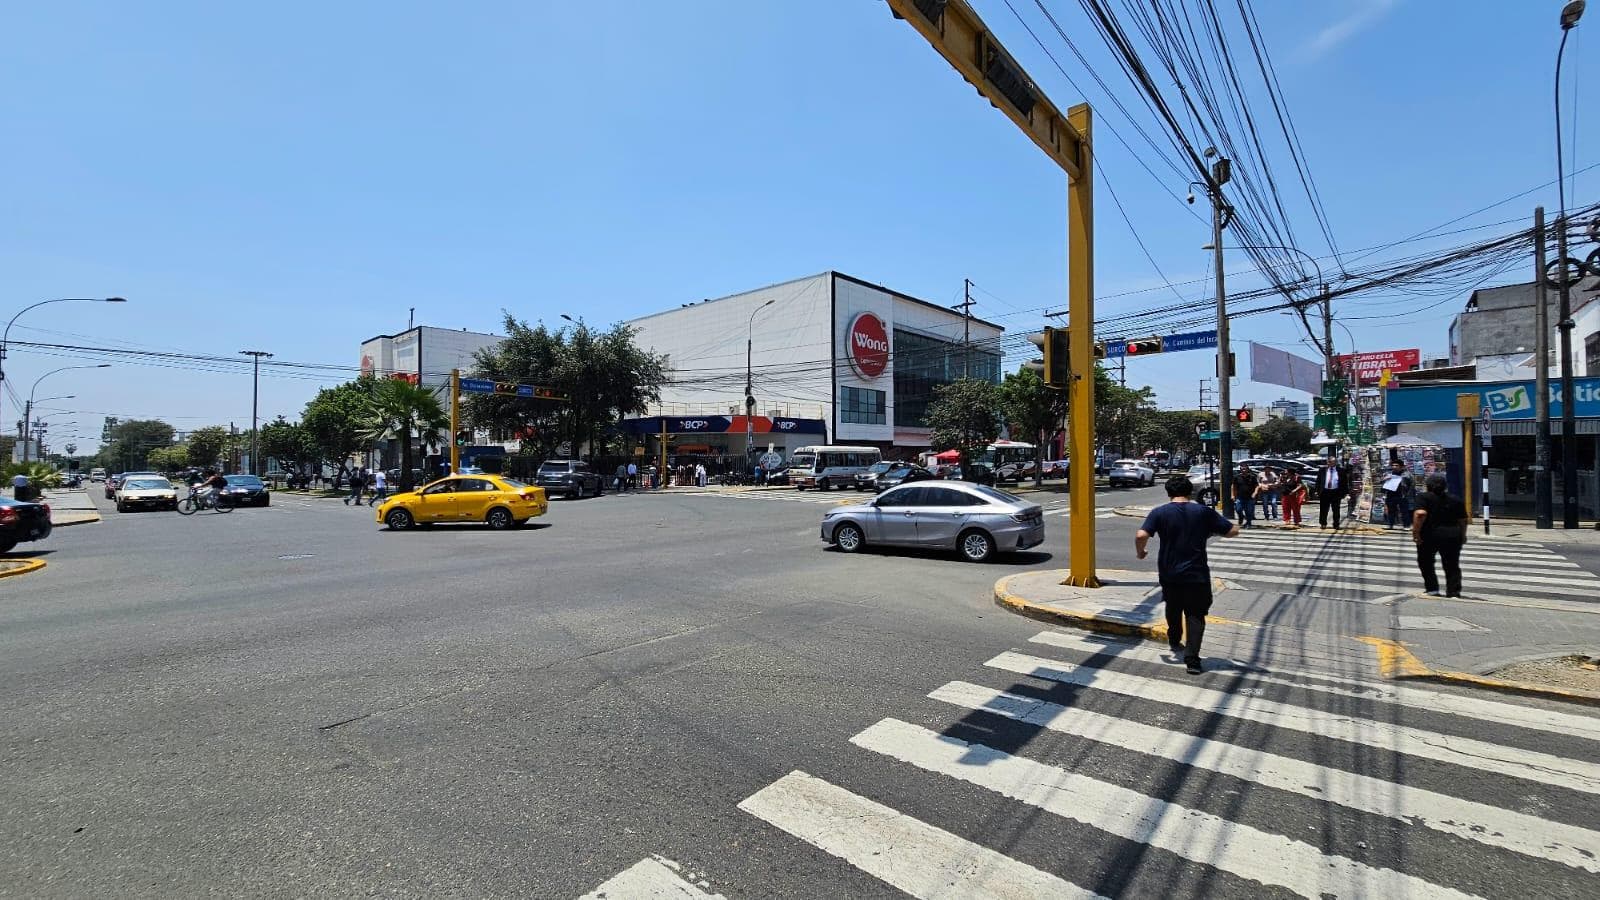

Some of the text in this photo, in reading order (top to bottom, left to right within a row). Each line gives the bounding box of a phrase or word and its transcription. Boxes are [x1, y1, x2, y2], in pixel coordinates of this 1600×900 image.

[1107, 345, 1126, 354] SURCO
[685, 420, 704, 429] BCP
[781, 421, 794, 429] BCP
